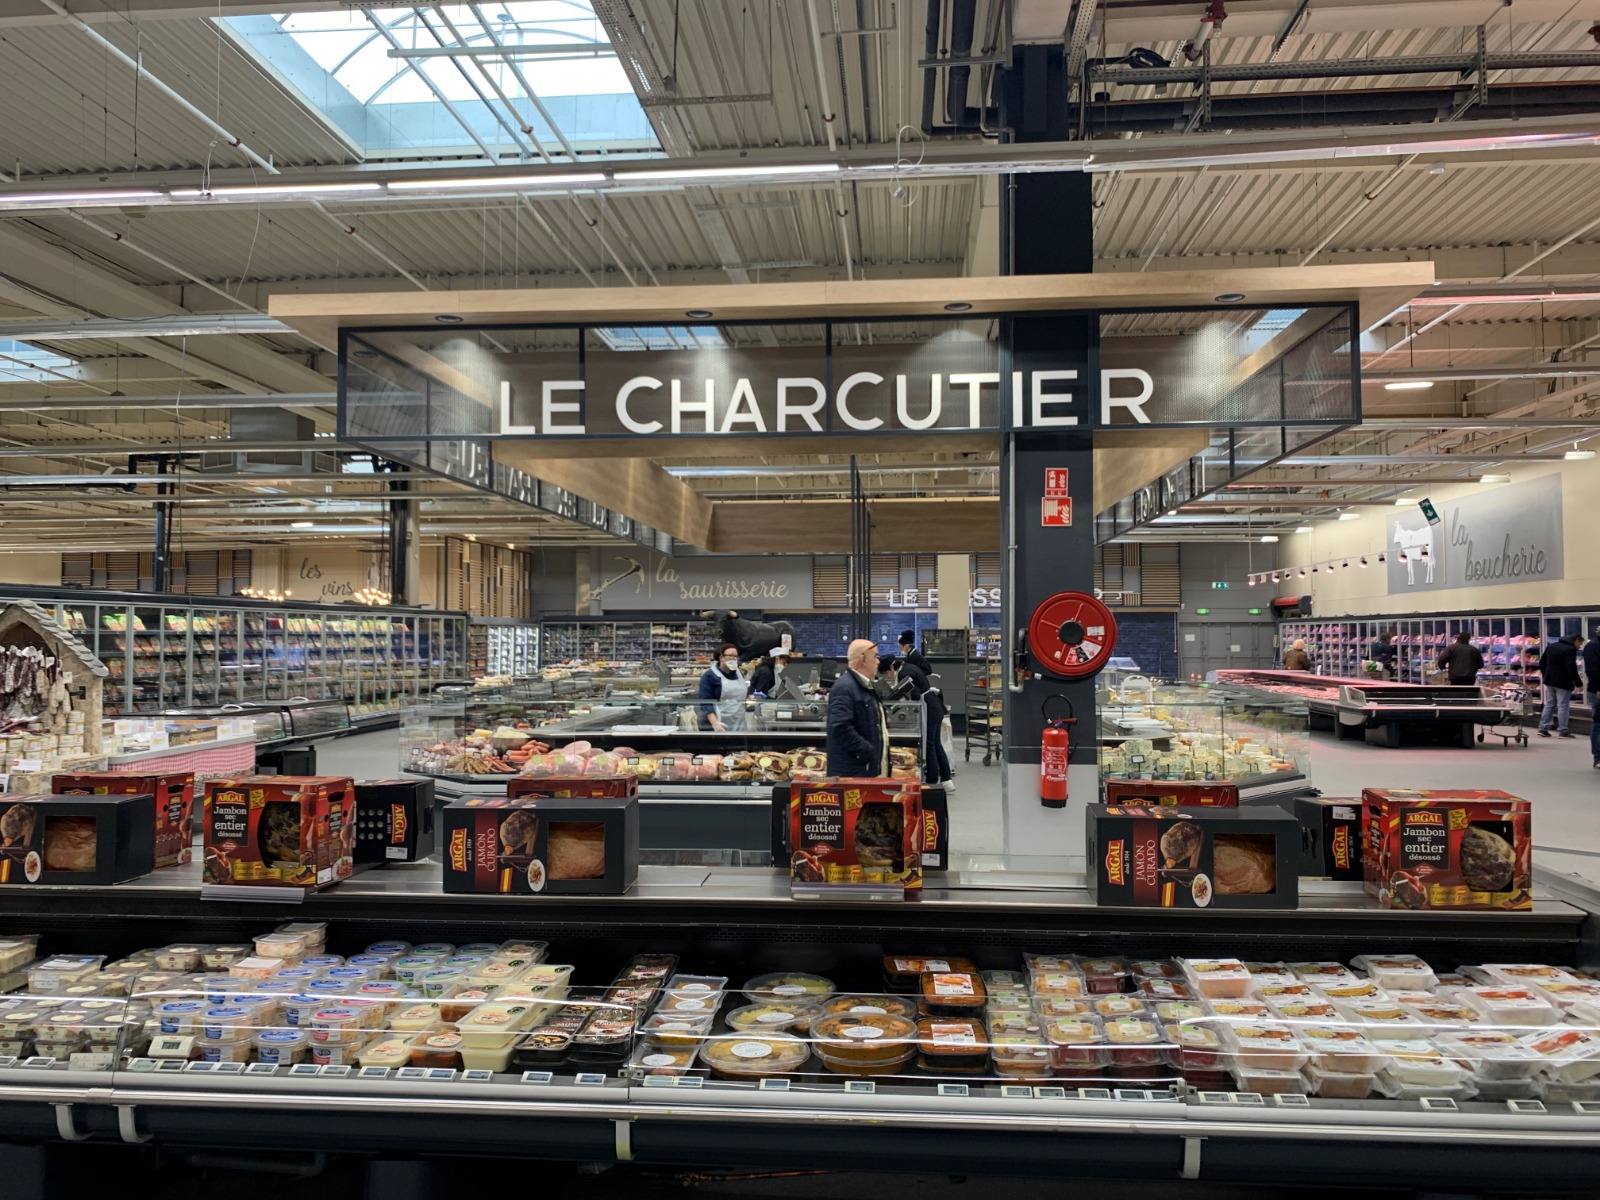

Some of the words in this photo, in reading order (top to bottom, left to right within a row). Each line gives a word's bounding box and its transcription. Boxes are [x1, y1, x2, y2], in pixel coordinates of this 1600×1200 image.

[500, 380, 586, 435] LE
[616, 368, 1154, 434] CHARCUTIER
[1452, 507, 1469, 547] la
[1465, 533, 1547, 581] boucherie
[300, 557, 324, 579] les
[655, 556, 679, 583] la
[321, 581, 355, 596] vins
[680, 580, 789, 600] saurisserie
[889, 588, 919, 607] LE
[217, 793, 245, 802] ARGAL
[807, 794, 837, 803] ARGAL
[213, 806, 247, 815] Jambon
[803, 807, 842, 816] Jambon
[1408, 813, 1441, 823] ARGAL
[214, 820, 246, 831] entier
[394, 806, 404, 840] ARGAL
[804, 821, 841, 833] entier
[925, 812, 936, 848] ARGAL
[1403, 827, 1446, 837] Jambon
[217, 830, 243, 838] désossé
[808, 833, 837, 841] désossé
[453, 831, 464, 869] ARGAL
[476, 833, 487, 867] JAMÓN
[487, 828, 495, 872] CURADO
[1335, 828, 1347, 867] ARGAL
[1404, 842, 1446, 854] entier
[1408, 853, 1441, 861] désossé
[1110, 842, 1121, 882] ARGAL
[1134, 845, 1146, 880] JAMÓN
[1147, 840, 1156, 885] CURADO
